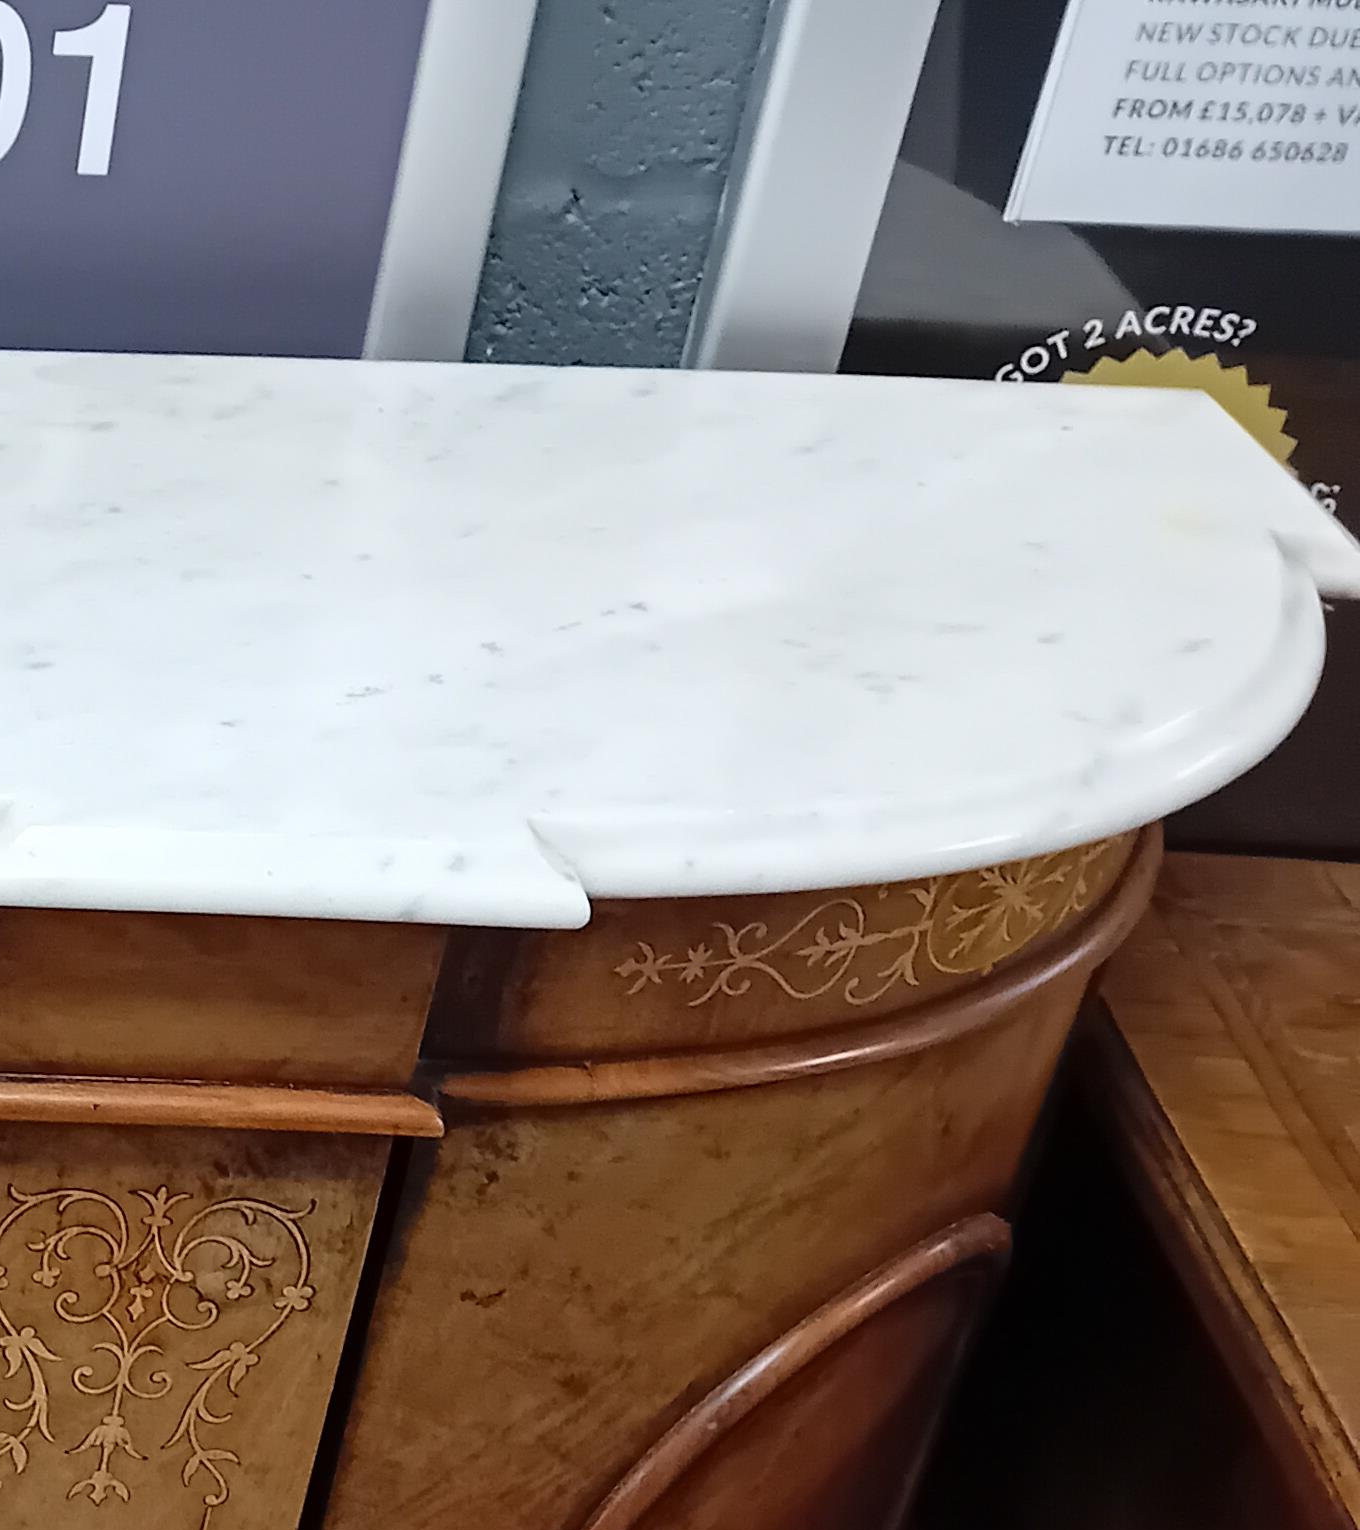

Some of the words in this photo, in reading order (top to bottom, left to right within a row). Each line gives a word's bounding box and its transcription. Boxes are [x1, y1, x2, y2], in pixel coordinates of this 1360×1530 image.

[1135, 22, 1203, 44] NEW
[1206, 23, 1302, 46] STOCK
[1125, 60, 1186, 83] FULL
[1196, 62, 1321, 86] OPTIONS
[1112, 98, 1194, 120] FROM
[1314, 109, 1328, 121] +
[1104, 135, 1156, 157] TEL:
[1161, 137, 1244, 160] 01686
[994, 330, 1070, 383] GOT
[1083, 318, 1106, 350] 2
[1114, 305, 1257, 348] ACRES?
